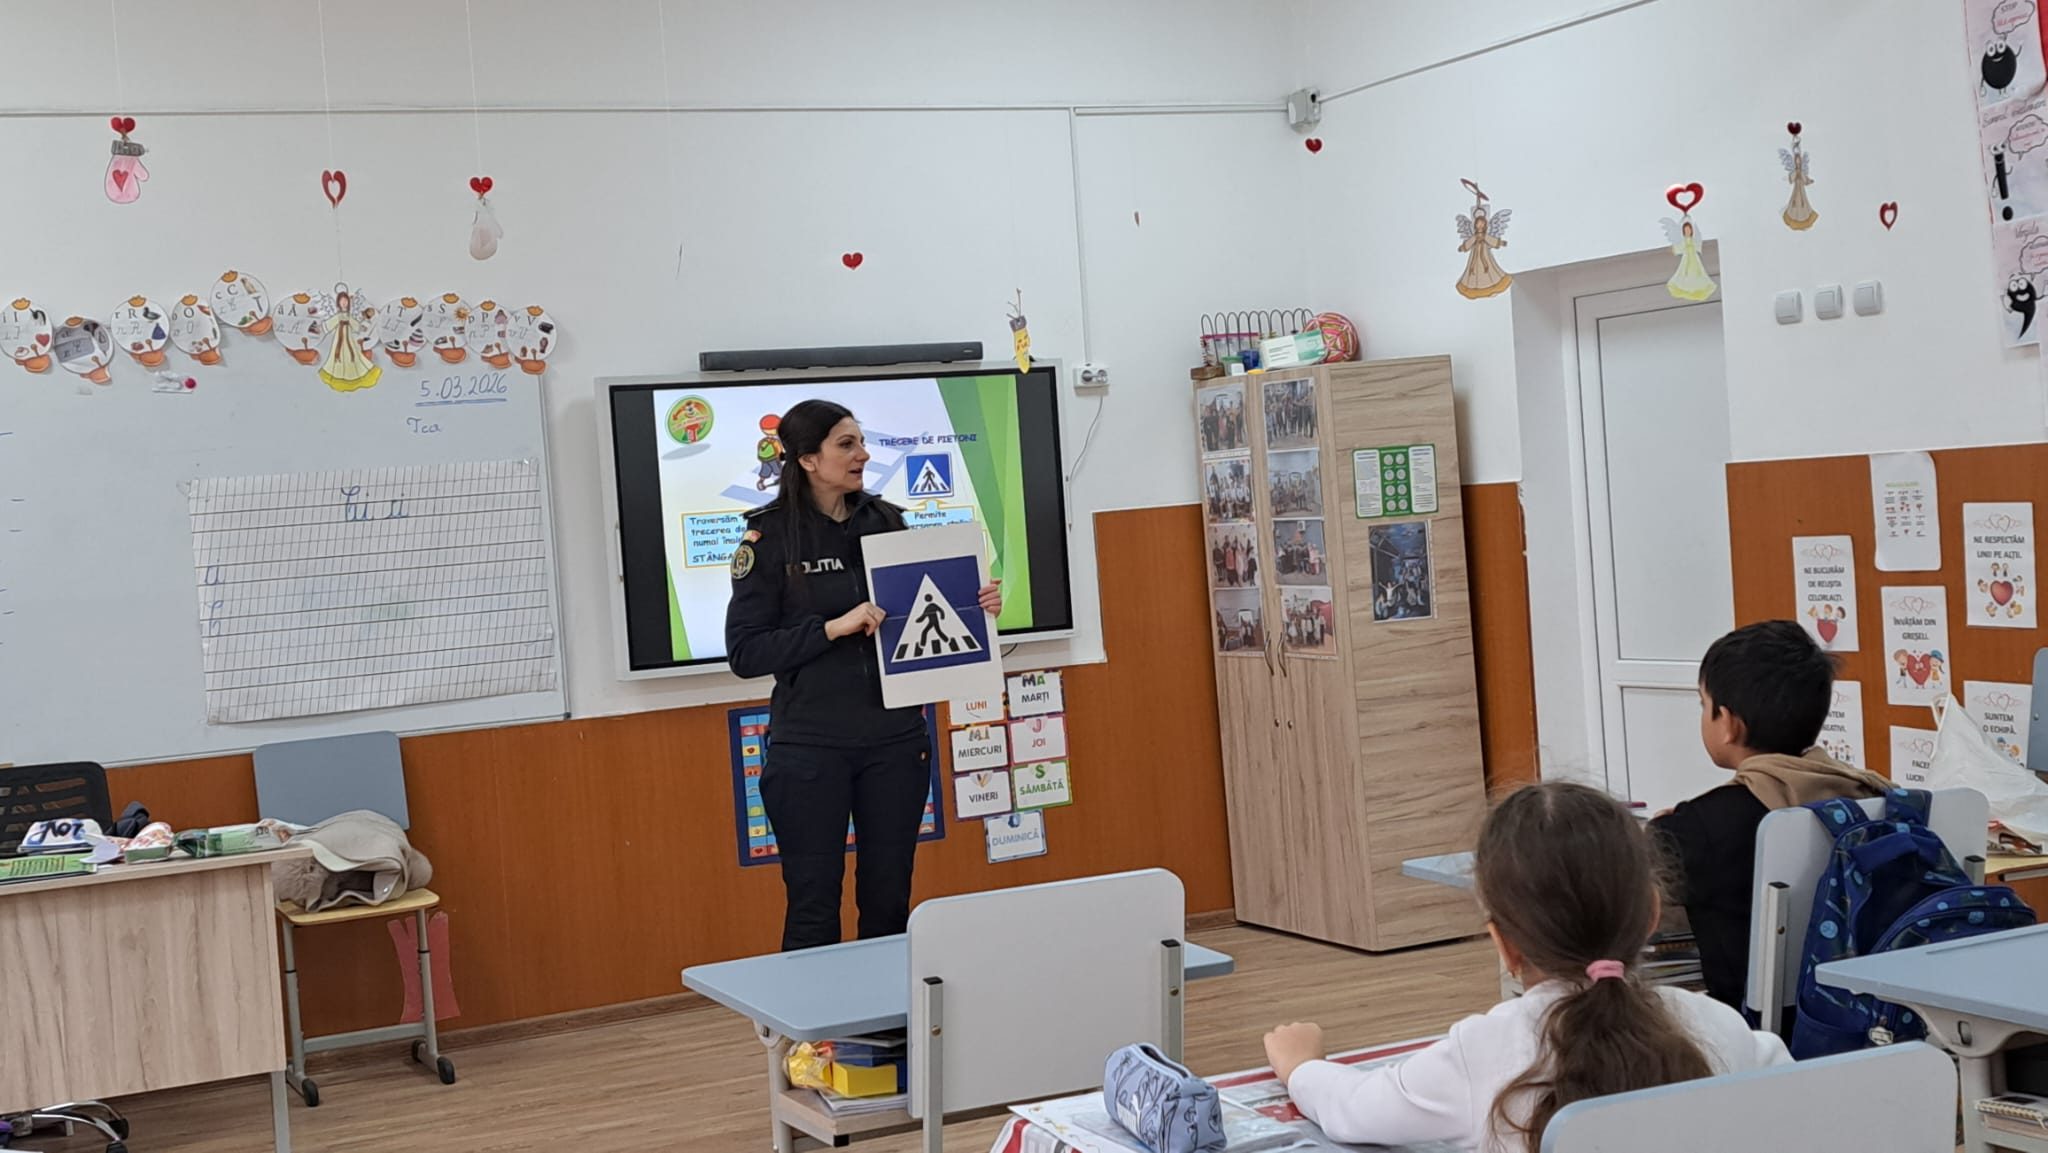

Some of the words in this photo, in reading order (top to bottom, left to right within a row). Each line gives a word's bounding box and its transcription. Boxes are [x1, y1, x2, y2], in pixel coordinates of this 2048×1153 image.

[226, 284, 239, 296] C
[128, 308, 139, 319] R
[184, 307, 195, 319] O
[438, 303, 447, 315] S
[480, 312, 489, 322] P
[527, 316, 536, 326] V
[420, 372, 508, 399] 5.03.2026
[879, 437, 919, 447] TRECERE
[922, 435, 934, 445] DE
[937, 433, 977, 443] PIETONI
[688, 515, 738, 526] Traversăm
[914, 511, 947, 520] Permite
[691, 528, 732, 537] trecerea
[1021, 674, 1046, 688] MA
[1021, 692, 1050, 703] MARȚI
[966, 700, 987, 711] LUNI
[1984, 711, 2014, 722] SUNTEM
[1032, 718, 1043, 733] J
[1983, 724, 1989, 733] O
[1031, 738, 1046, 748] JOI
[958, 744, 1002, 759] MIERCURI
[1034, 764, 1046, 779] S
[976, 773, 989, 788] V
[968, 791, 999, 803] VINERI
[991, 828, 1040, 847] DUMINICĂ
